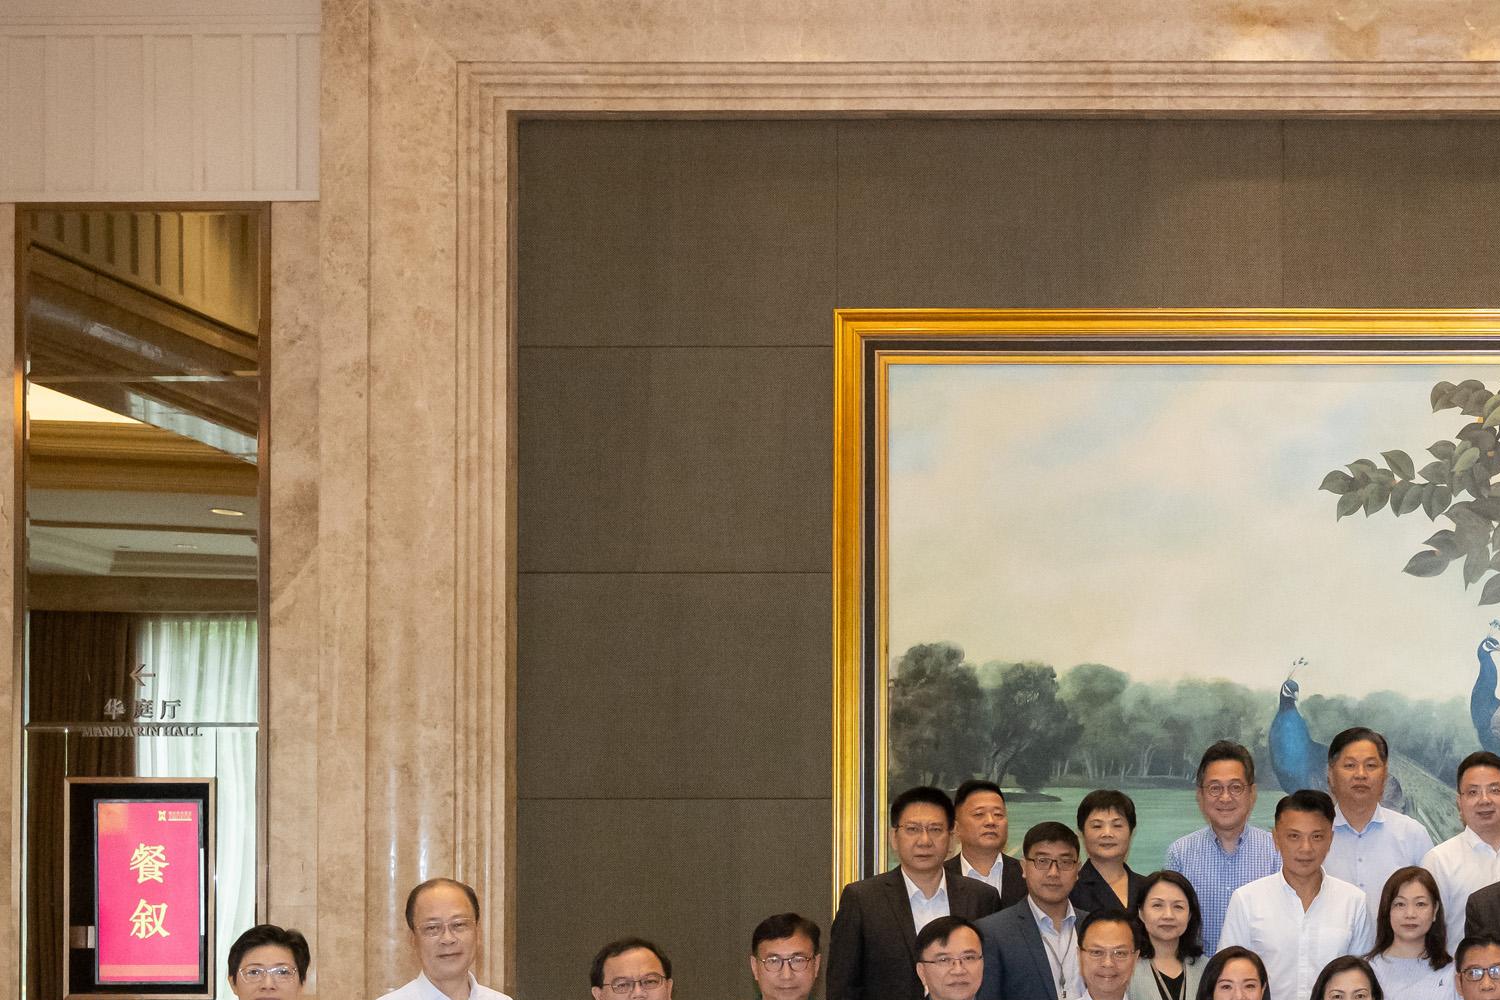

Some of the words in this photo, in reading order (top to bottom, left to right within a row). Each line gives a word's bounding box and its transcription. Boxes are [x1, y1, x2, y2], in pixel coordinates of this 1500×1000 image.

[103, 698, 181, 720] 华庭厅
[81, 726, 160, 737] MANDARIN
[163, 726, 203, 737] HALL
[129, 843, 170, 940] 餐叙
